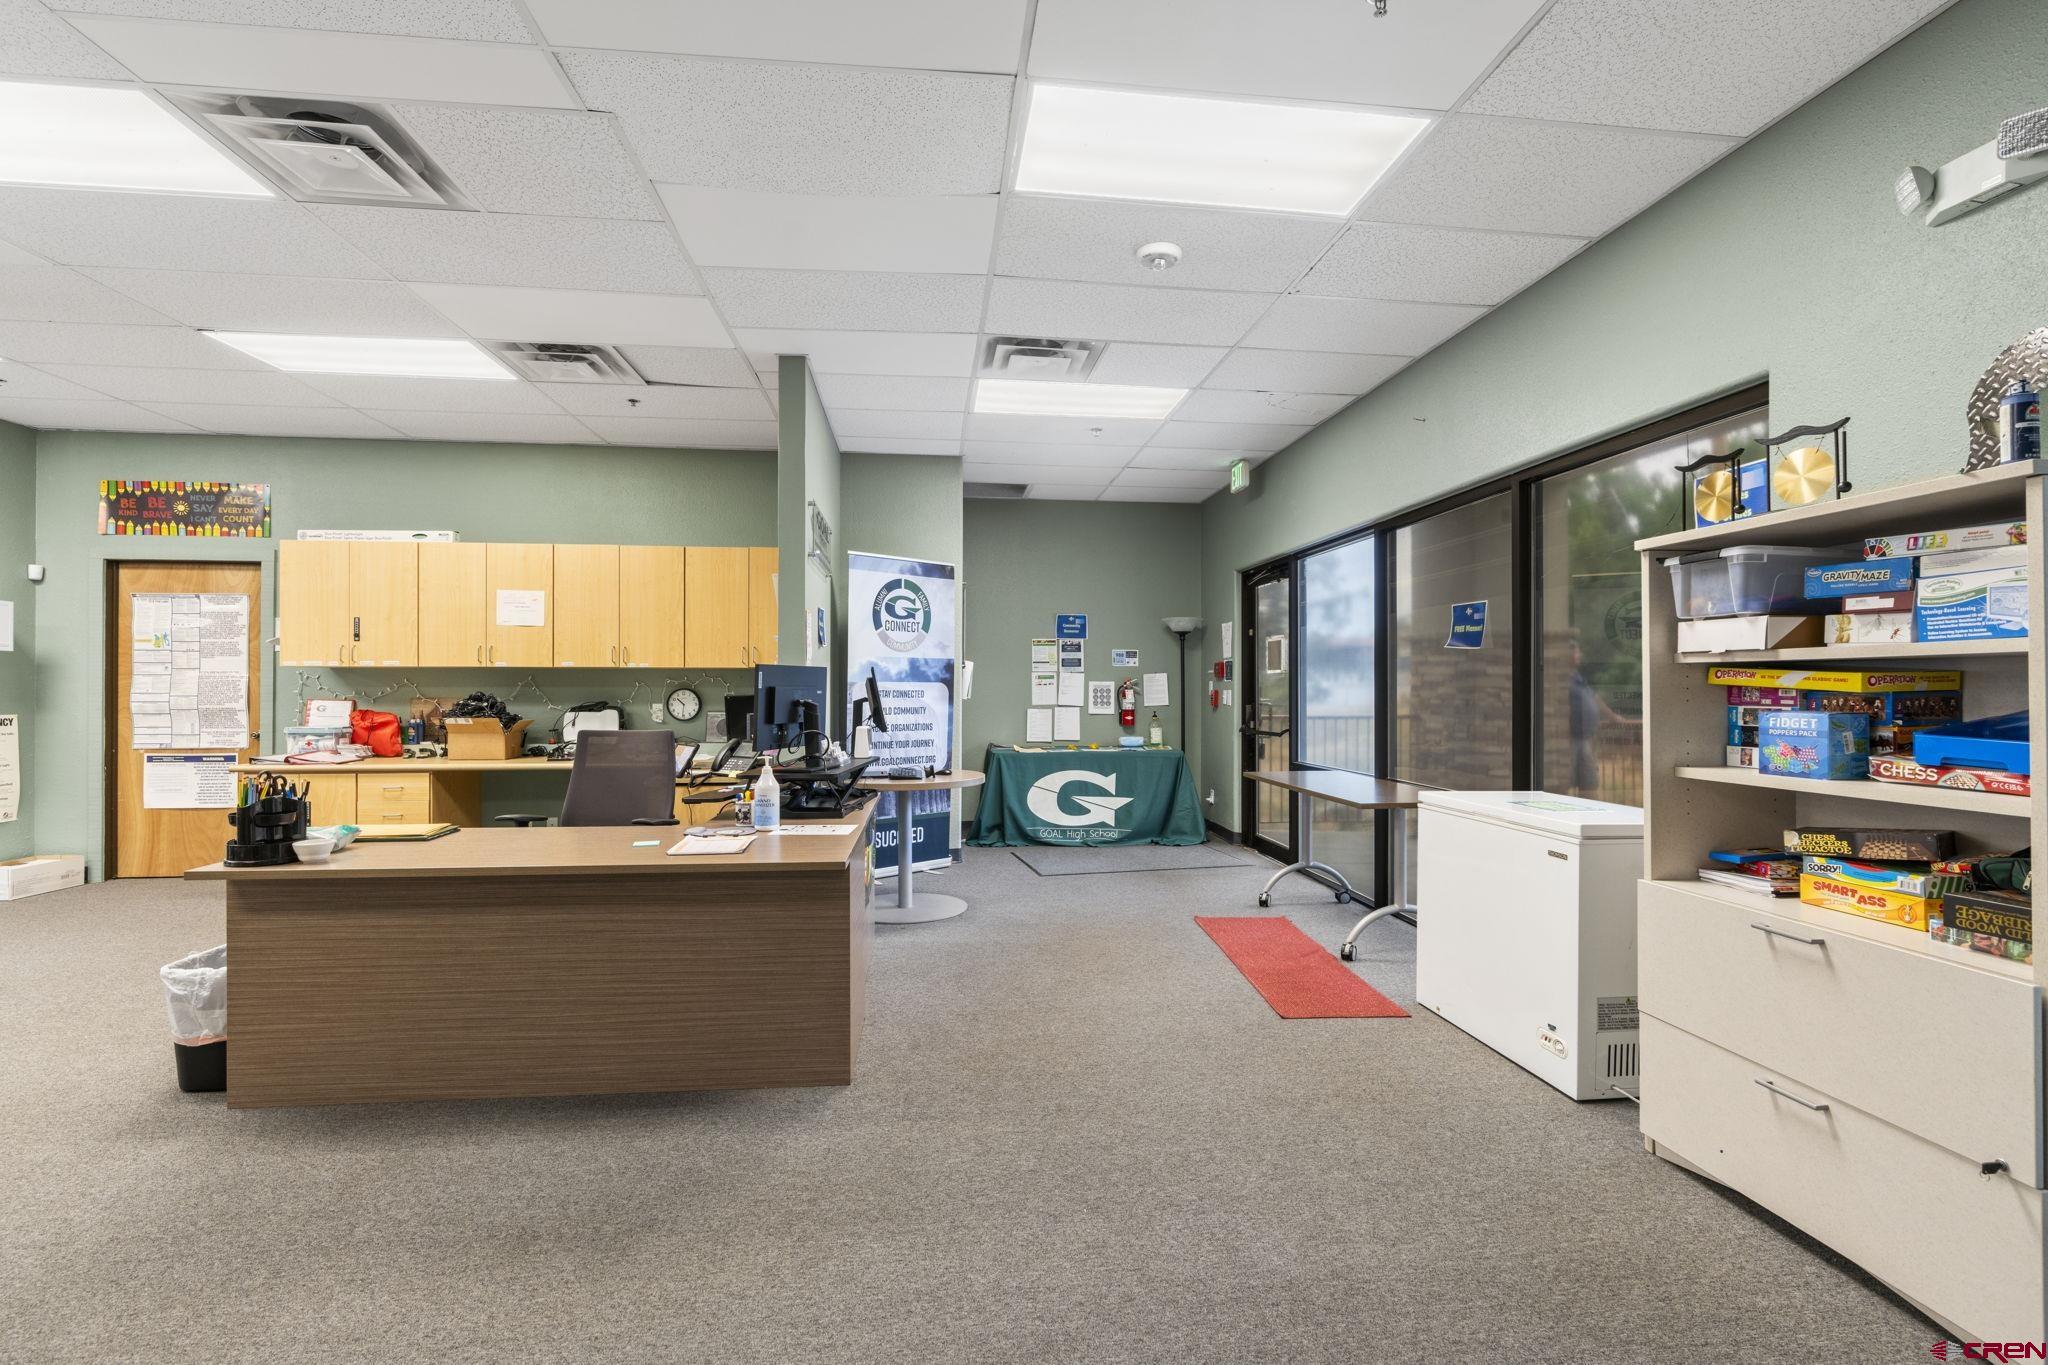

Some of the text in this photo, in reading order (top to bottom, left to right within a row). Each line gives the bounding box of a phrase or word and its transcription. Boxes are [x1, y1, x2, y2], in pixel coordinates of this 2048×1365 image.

[1232, 463, 1242, 491] EXIT
[120, 499, 136, 508] BE
[148, 497, 167, 508] BE
[224, 496, 254, 505] MAKE
[193, 504, 214, 512] SAY
[143, 511, 172, 519] BRAVE
[1907, 532, 1948, 551] LIFE
[1822, 569, 1862, 582] GRAVITY
[1860, 570, 1890, 582] MAZE
[874, 588, 888, 610] ALUMNI
[916, 591, 930, 611] FAMILY
[884, 620, 920, 633] CONNECT
[1715, 669, 1757, 679] OPERATION
[1868, 675, 1916, 686] OPERATION
[892, 690, 925, 699] CONNECTED
[894, 707, 926, 715] COMMUNITY
[891, 723, 933, 732] ORGANIZATIONS
[1769, 718, 1818, 729] FIDGET
[896, 740, 910, 749] YOUR
[911, 739, 934, 748] JOURNEY
[1880, 764, 1938, 781] CHESS
[1027, 770, 1134, 826] G
[876, 827, 924, 848] SUCED
[1040, 828, 1118, 840] GOAL High School
[1808, 863, 1842, 874] SORRY!
[1813, 881, 1858, 898] SMART
[1856, 895, 1887, 908] ASS
[1955, 904, 2032, 931] RIBBAGE
[1956, 919, 2001, 935] WOOD
